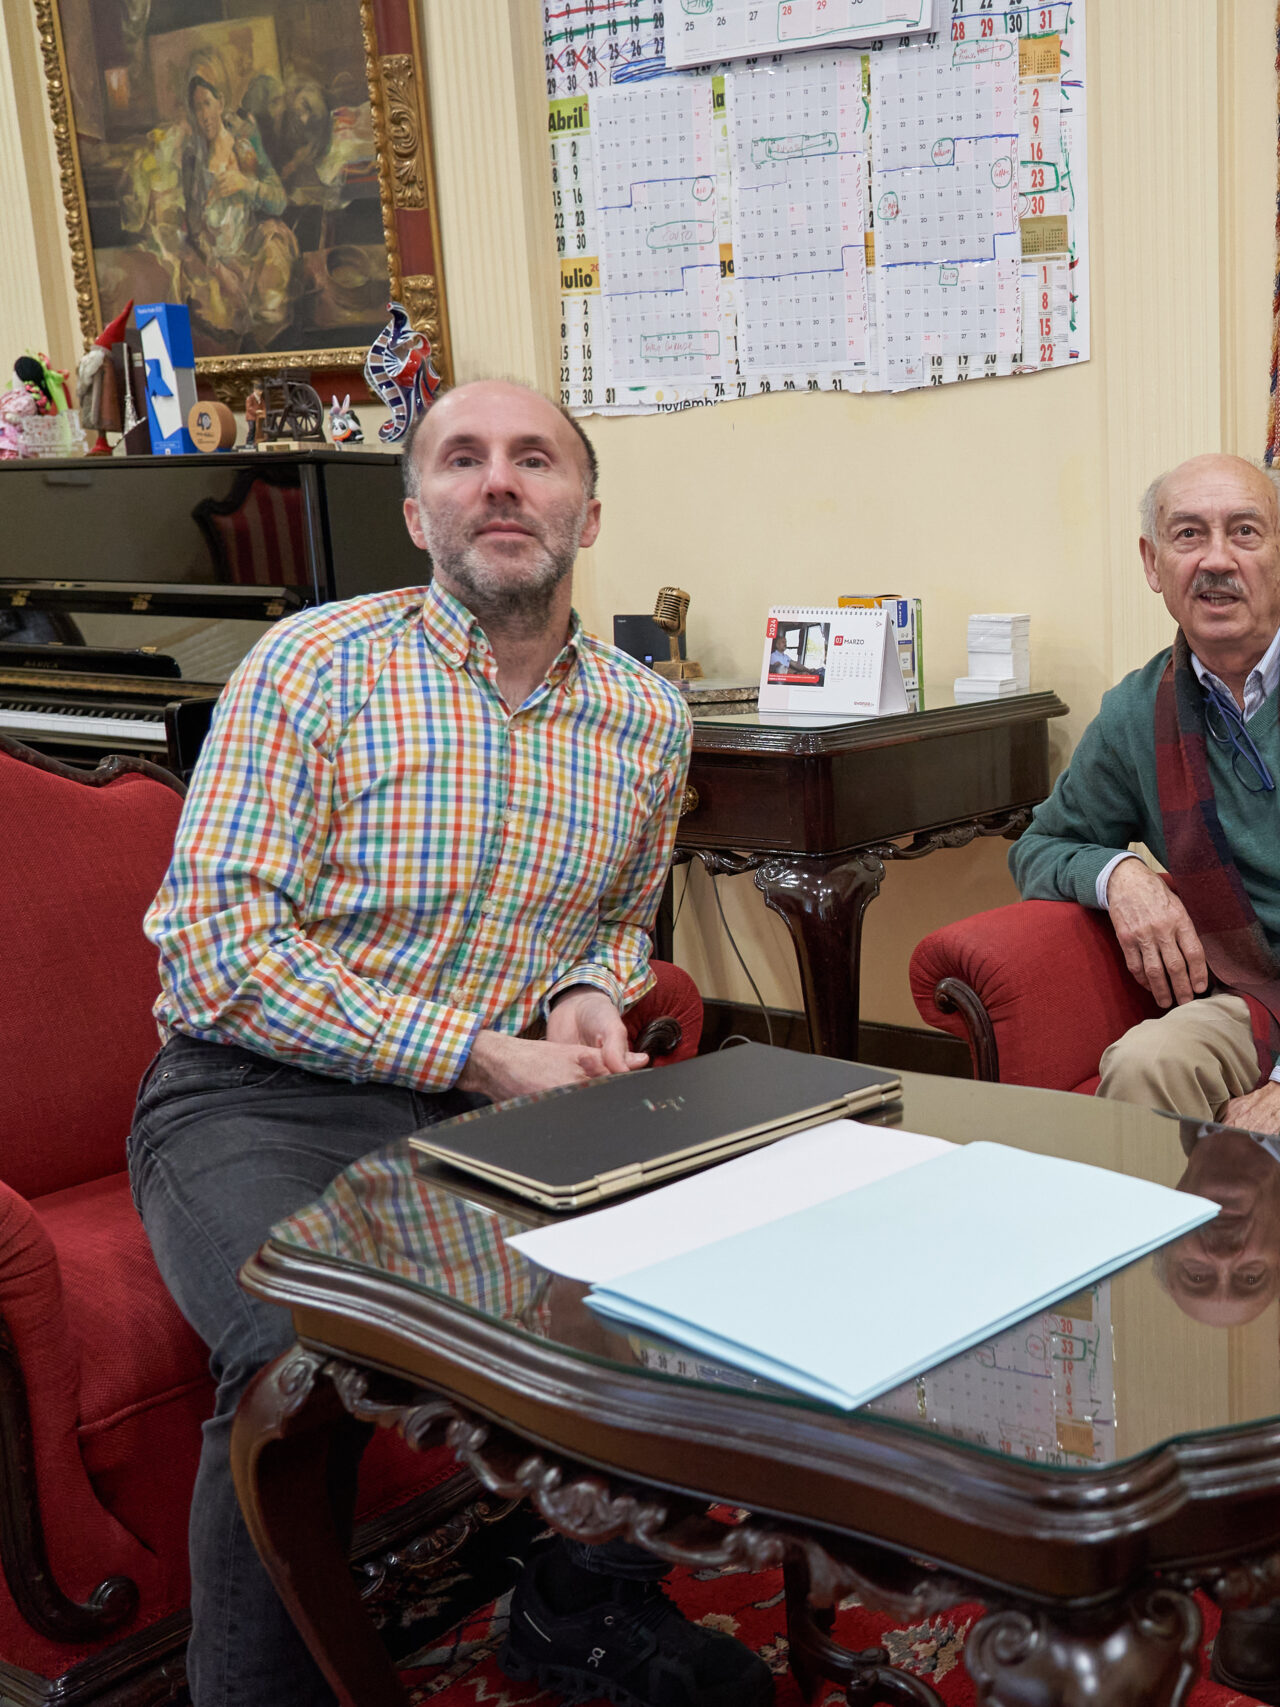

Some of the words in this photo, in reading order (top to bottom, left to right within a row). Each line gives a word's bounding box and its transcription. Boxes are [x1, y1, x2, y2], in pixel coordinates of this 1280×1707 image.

[686, 21, 694, 31] 25
[717, 17, 726, 26] 26
[749, 11, 757, 21] 27
[782, 7, 792, 15] 28
[817, 1, 826, 10] 29
[952, 22, 965, 40] 28
[981, 18, 993, 37] 29
[1009, 14, 1022, 33] 30
[1040, 10, 1052, 29] 31
[586, 23, 595, 40] 17
[608, 19, 617, 36] 18
[630, 16, 640, 32] 19
[654, 12, 664, 29] 20
[609, 43, 619, 60] 25
[631, 40, 641, 56] 26
[654, 37, 664, 54] 27
[547, 78, 556, 94] 29
[567, 74, 576, 90] 30
[589, 71, 598, 88] 31
[1033, 88, 1039, 106] 2
[549, 106, 583, 131] Abril
[1033, 115, 1039, 134] 9
[552, 144, 555, 160] 1
[572, 141, 576, 157] 2
[1031, 142, 1042, 160] 16
[553, 168, 557, 183] 8
[573, 165, 578, 180] 9
[1032, 168, 1044, 187] 23
[553, 191, 561, 206] 15
[573, 188, 582, 204] 16
[1032, 196, 1044, 214] 30
[555, 213, 564, 229] 22
[576, 211, 584, 226] 23
[557, 236, 565, 252] 29
[577, 234, 586, 249] 30
[1042, 266, 1047, 284] 1
[561, 302, 564, 316] 1
[583, 300, 588, 315] 2
[1042, 292, 1048, 310] 8
[561, 323, 566, 338] 8
[584, 322, 588, 337] 9
[1040, 318, 1051, 336] 15
[582, 345, 591, 359] 16
[1040, 344, 1054, 361] 22
[560, 368, 569, 382] 22
[583, 367, 592, 381] 23
[560, 390, 569, 404] 29
[583, 389, 592, 404] 30
[606, 388, 615, 403] 31
[737, 382, 746, 397] 27
